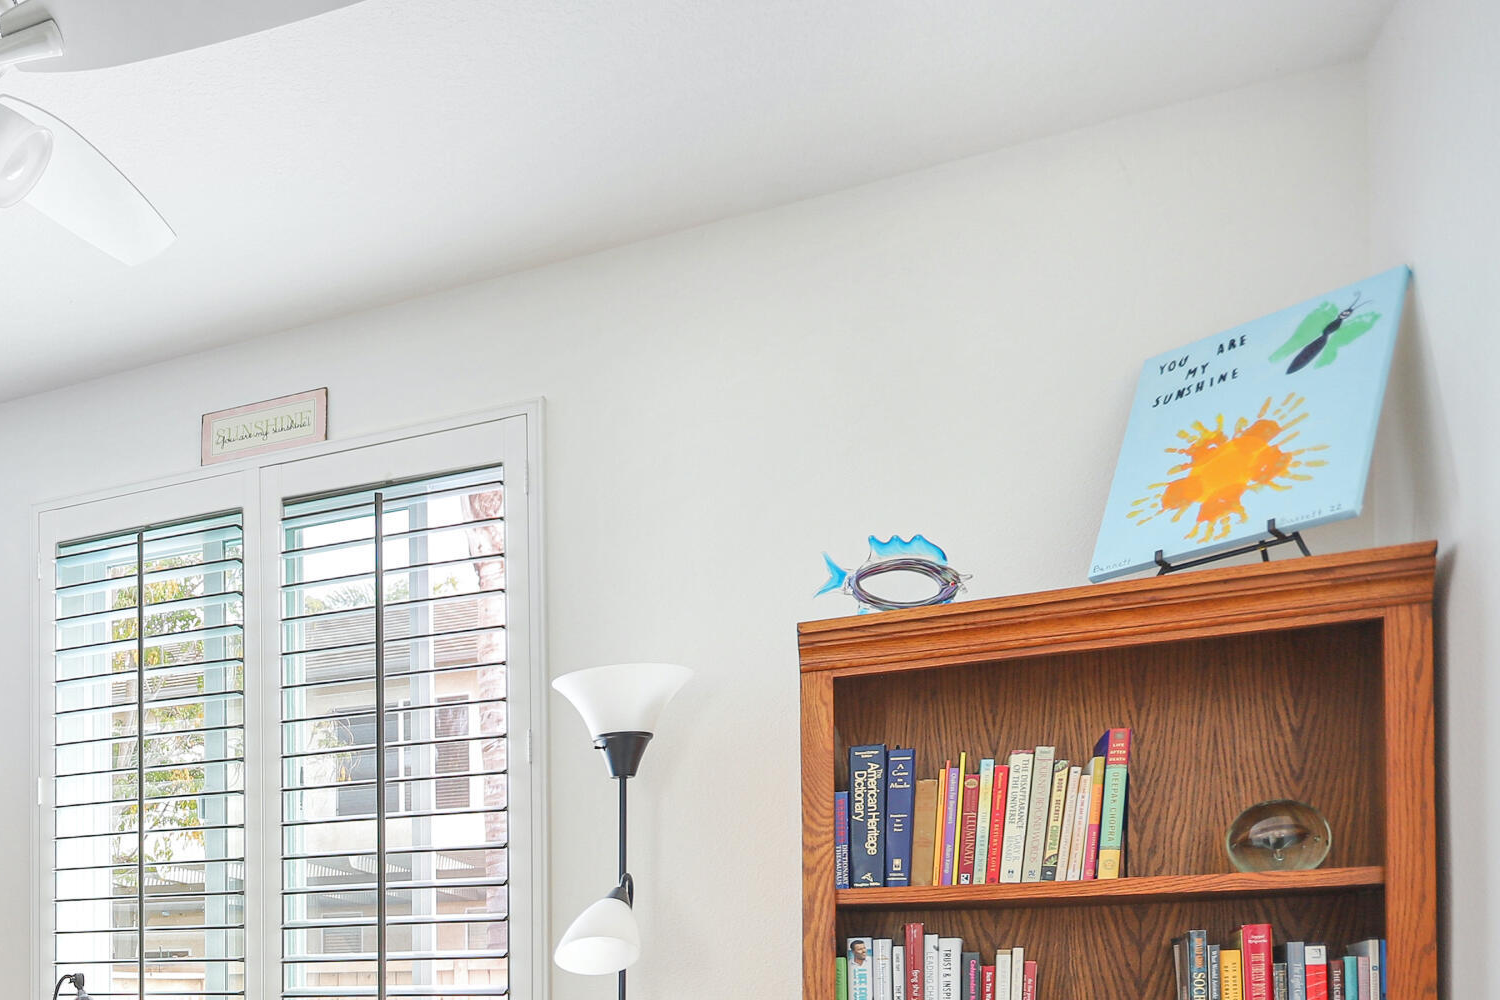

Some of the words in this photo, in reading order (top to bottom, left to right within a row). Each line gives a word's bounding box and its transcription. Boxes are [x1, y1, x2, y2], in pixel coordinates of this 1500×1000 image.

[1158, 354, 1190, 377] YOU
[1216, 333, 1248, 358] ARE
[1184, 361, 1210, 381] MY
[1151, 367, 1240, 410] SUNSHINE
[215, 409, 312, 445] SUNSHINE
[1013, 765, 1021, 774] OF
[1021, 759, 1030, 773] THE
[852, 770, 867, 822] Dictionary
[867, 762, 881, 811] American
[1012, 776, 1020, 790] THE
[1109, 772, 1120, 805] DEEPAK
[1009, 791, 1018, 825] UNIVERSE
[864, 812, 880, 856] Heritage
[1107, 807, 1118, 842] CHOPRA
[963, 812, 977, 866] ILLUMINATA
[841, 844, 849, 886] DICTIONARY
[926, 951, 934, 984] LEADING
[943, 949, 952, 971] TRUST
[1210, 950, 1218, 964] What
[1251, 952, 1266, 962] THE
[857, 968, 868, 985] LIFE
[910, 969, 920, 983] feng
[968, 959, 976, 995] Codependent
[1210, 964, 1218, 980] Would
[1333, 969, 1341, 982] THE
[912, 983, 920, 997] shui
[1252, 983, 1266, 996] BOOK
